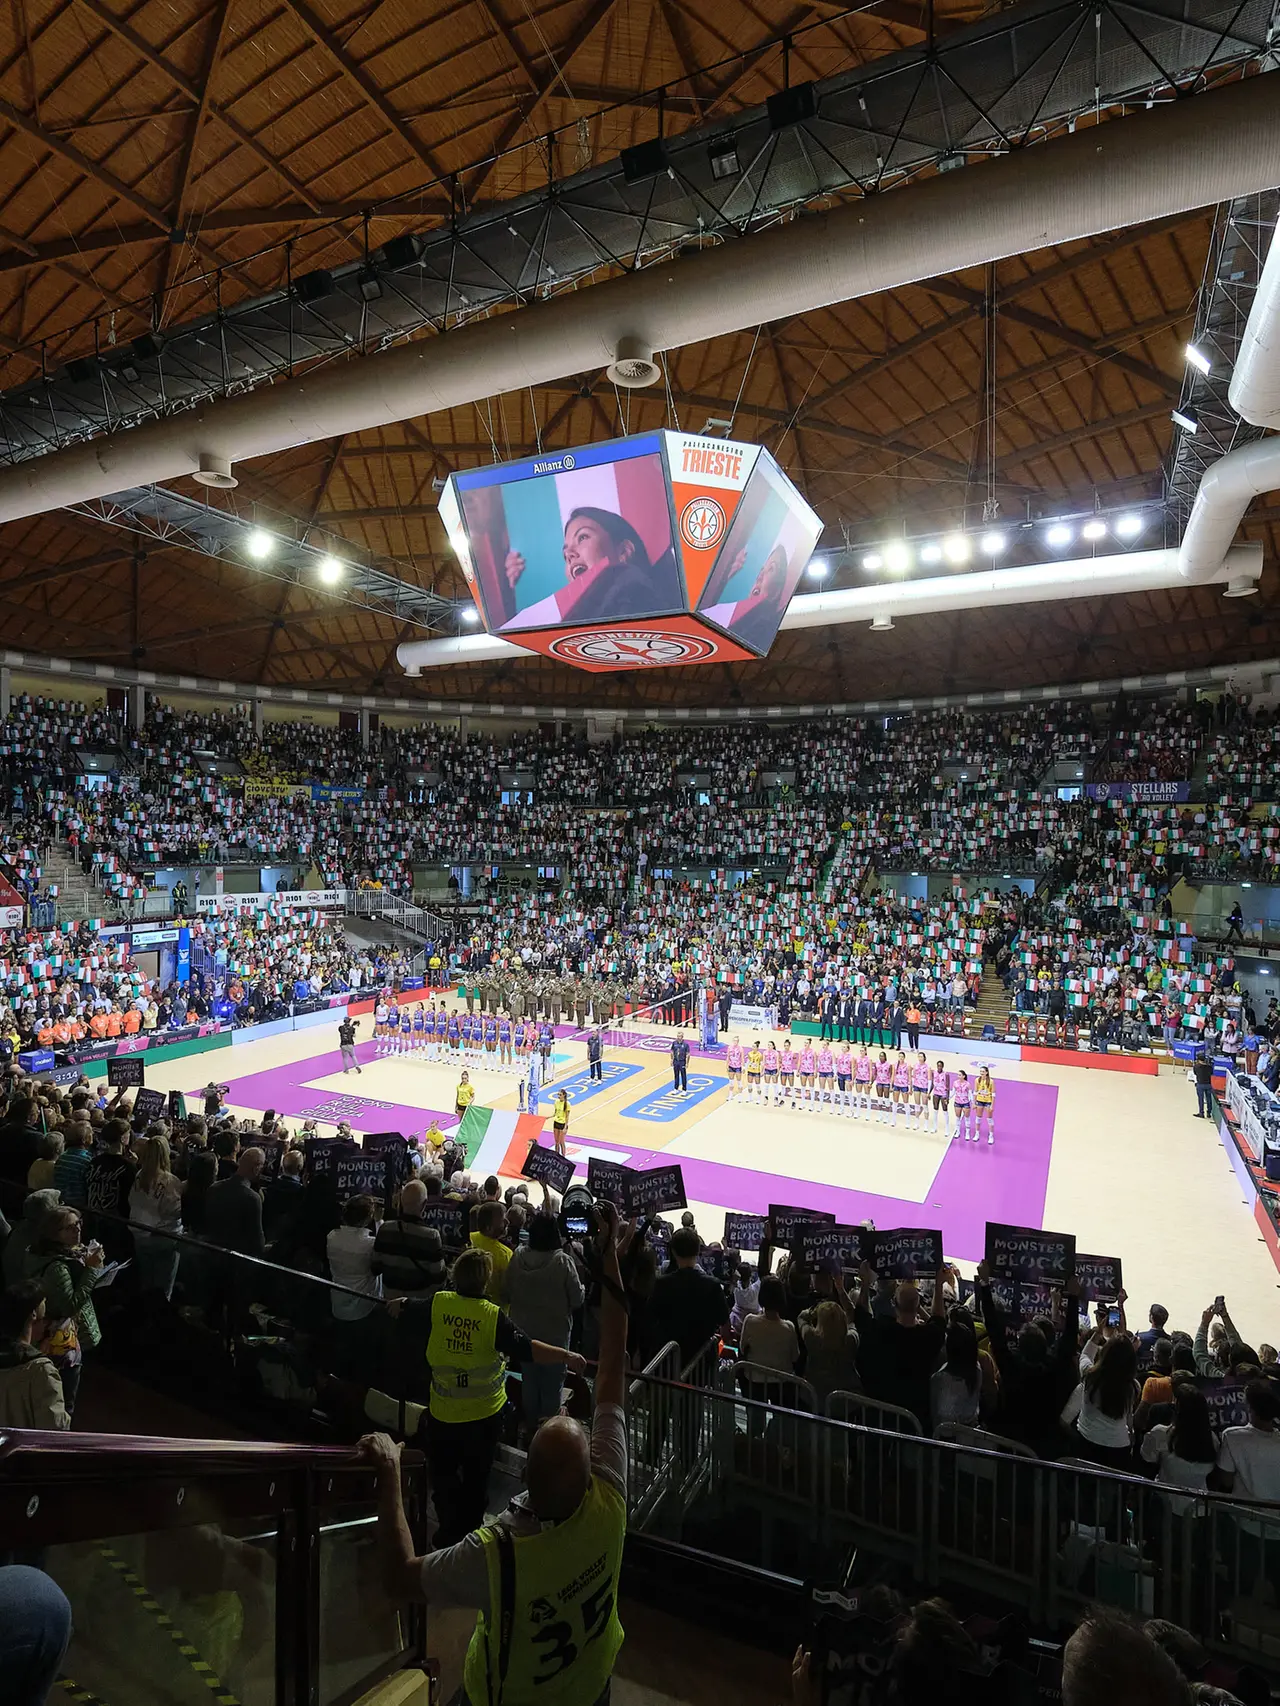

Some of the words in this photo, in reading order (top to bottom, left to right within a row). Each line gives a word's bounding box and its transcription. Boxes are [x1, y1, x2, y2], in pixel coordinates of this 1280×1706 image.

[533, 460, 563, 474] Allianz
[682, 448, 742, 480] TRIESTE
[1131, 782, 1178, 794] STELLARS
[199, 899, 217, 907] R101
[55, 1070, 79, 1083] 3:14
[112, 1070, 140, 1080] BLOCK
[637, 1077, 714, 1118] FINECO
[337, 1161, 386, 1172] MONSTER
[532, 1154, 569, 1174] MONSTER
[529, 1163, 566, 1183] BLOCK
[337, 1174, 387, 1189] BLOCK
[629, 1173, 676, 1193] MONSTER
[632, 1184, 679, 1206] BLOCK
[421, 1209, 463, 1221] ONSTER
[803, 1234, 860, 1246] MONSTER
[874, 1238, 933, 1253] MONSTER
[994, 1238, 1065, 1254] MONSTER
[805, 1247, 862, 1262] BLOCK
[876, 1250, 936, 1268] BLOCK
[995, 1253, 1066, 1271] BLOCK
[1078, 1276, 1116, 1289] OCK
[442, 1313, 482, 1331] WORK
[453, 1327, 471, 1341] ON
[446, 1338, 473, 1352] TIME
[456, 1374, 468, 1388] 18
[557, 1577, 579, 1600] LEGA
[579, 1553, 607, 1580] VOLLEY
[563, 1562, 606, 1604] FEMMINILE
[530, 1573, 613, 1686] 35
